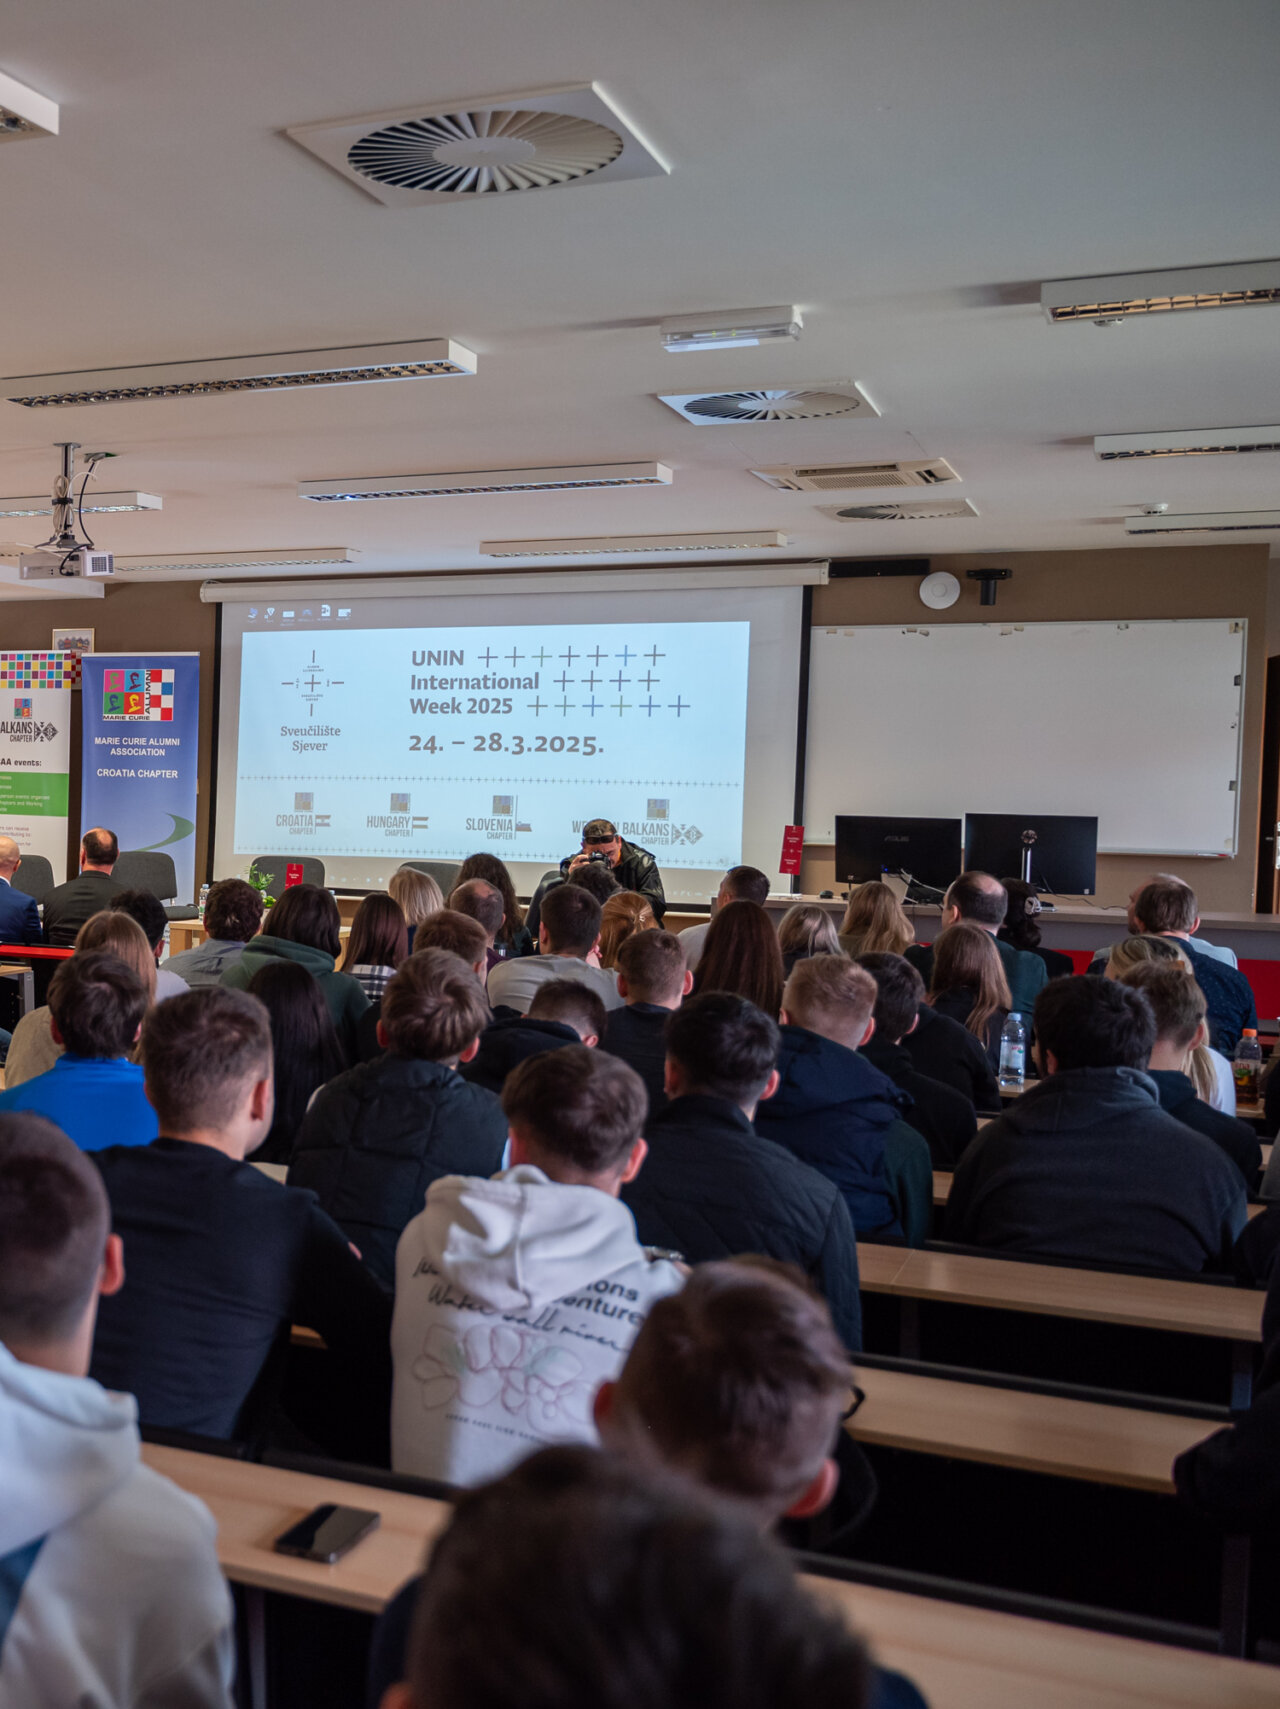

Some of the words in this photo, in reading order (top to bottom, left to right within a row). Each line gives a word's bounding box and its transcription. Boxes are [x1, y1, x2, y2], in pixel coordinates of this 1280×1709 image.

[412, 650, 464, 666] UNIN
[410, 671, 539, 690] International
[409, 697, 462, 714] Week
[466, 698, 513, 714] 2025
[280, 725, 341, 737] Sveučilište
[9, 735, 33, 743] CHAPTER
[94, 737, 120, 745] MARIE
[122, 737, 147, 745] CURIE
[149, 738, 180, 746] ALUMNI
[409, 735, 443, 754] 24.
[473, 732, 604, 756] 28.3.2025.
[110, 748, 166, 756] ASSOCIATION
[292, 740, 328, 754] Sjever
[14, 759, 42, 767] events:
[97, 769, 136, 777] CROATIA
[137, 769, 178, 778] CHAPTER
[275, 814, 313, 827] CROATIA
[366, 815, 411, 828] HUNGARY
[465, 818, 513, 831] SLOVENIA
[289, 827, 313, 835] CHAPTER
[384, 829, 410, 837] CHAPTER
[622, 821, 670, 836] BALKANS
[486, 831, 513, 840] CHAPTER
[641, 837, 669, 845] CHAPTER
